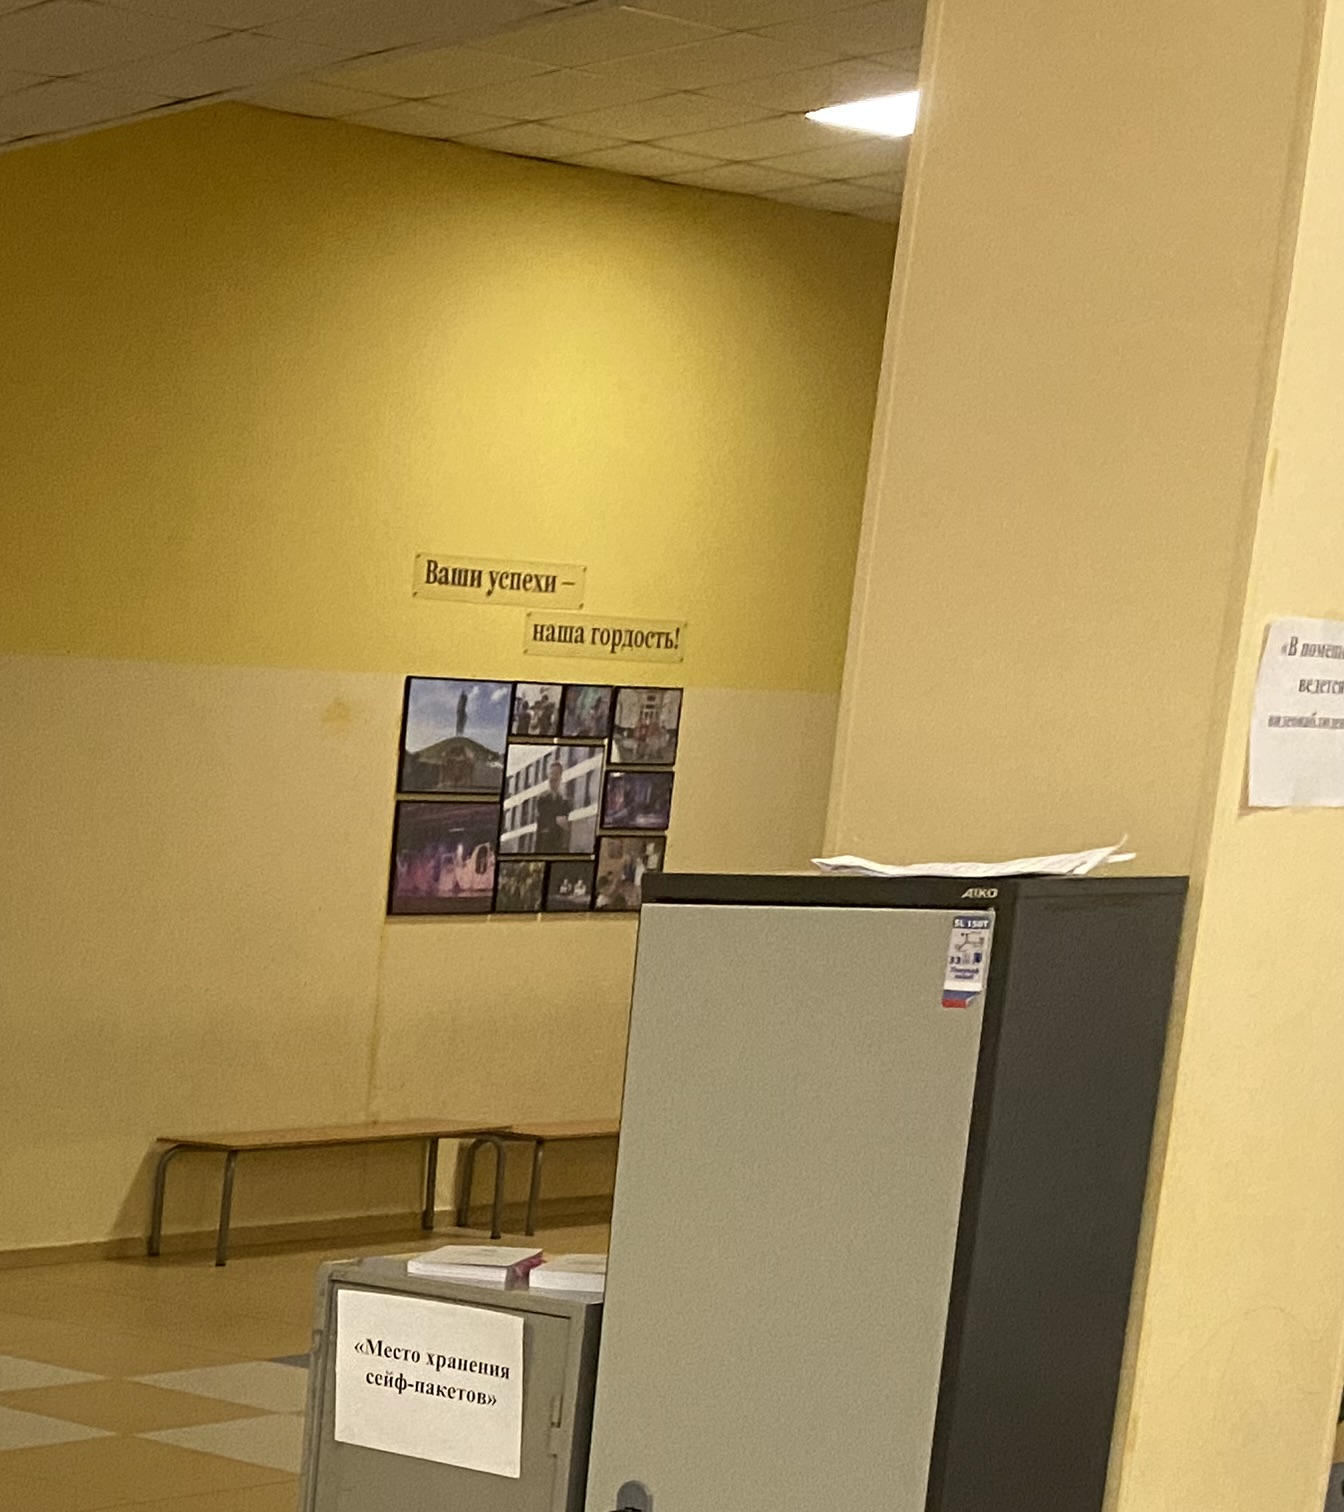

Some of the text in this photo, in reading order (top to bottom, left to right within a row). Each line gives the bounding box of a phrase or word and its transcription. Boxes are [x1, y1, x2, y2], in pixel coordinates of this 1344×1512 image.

[425, 560, 483, 589] Ваши
[486, 569, 558, 597] успехи
[532, 623, 681, 654] наша гордость!
[961, 888, 999, 899] AIKO
[354, 1338, 511, 1380] «Место хранения
[366, 1369, 498, 1406] сейф-пакетов»
